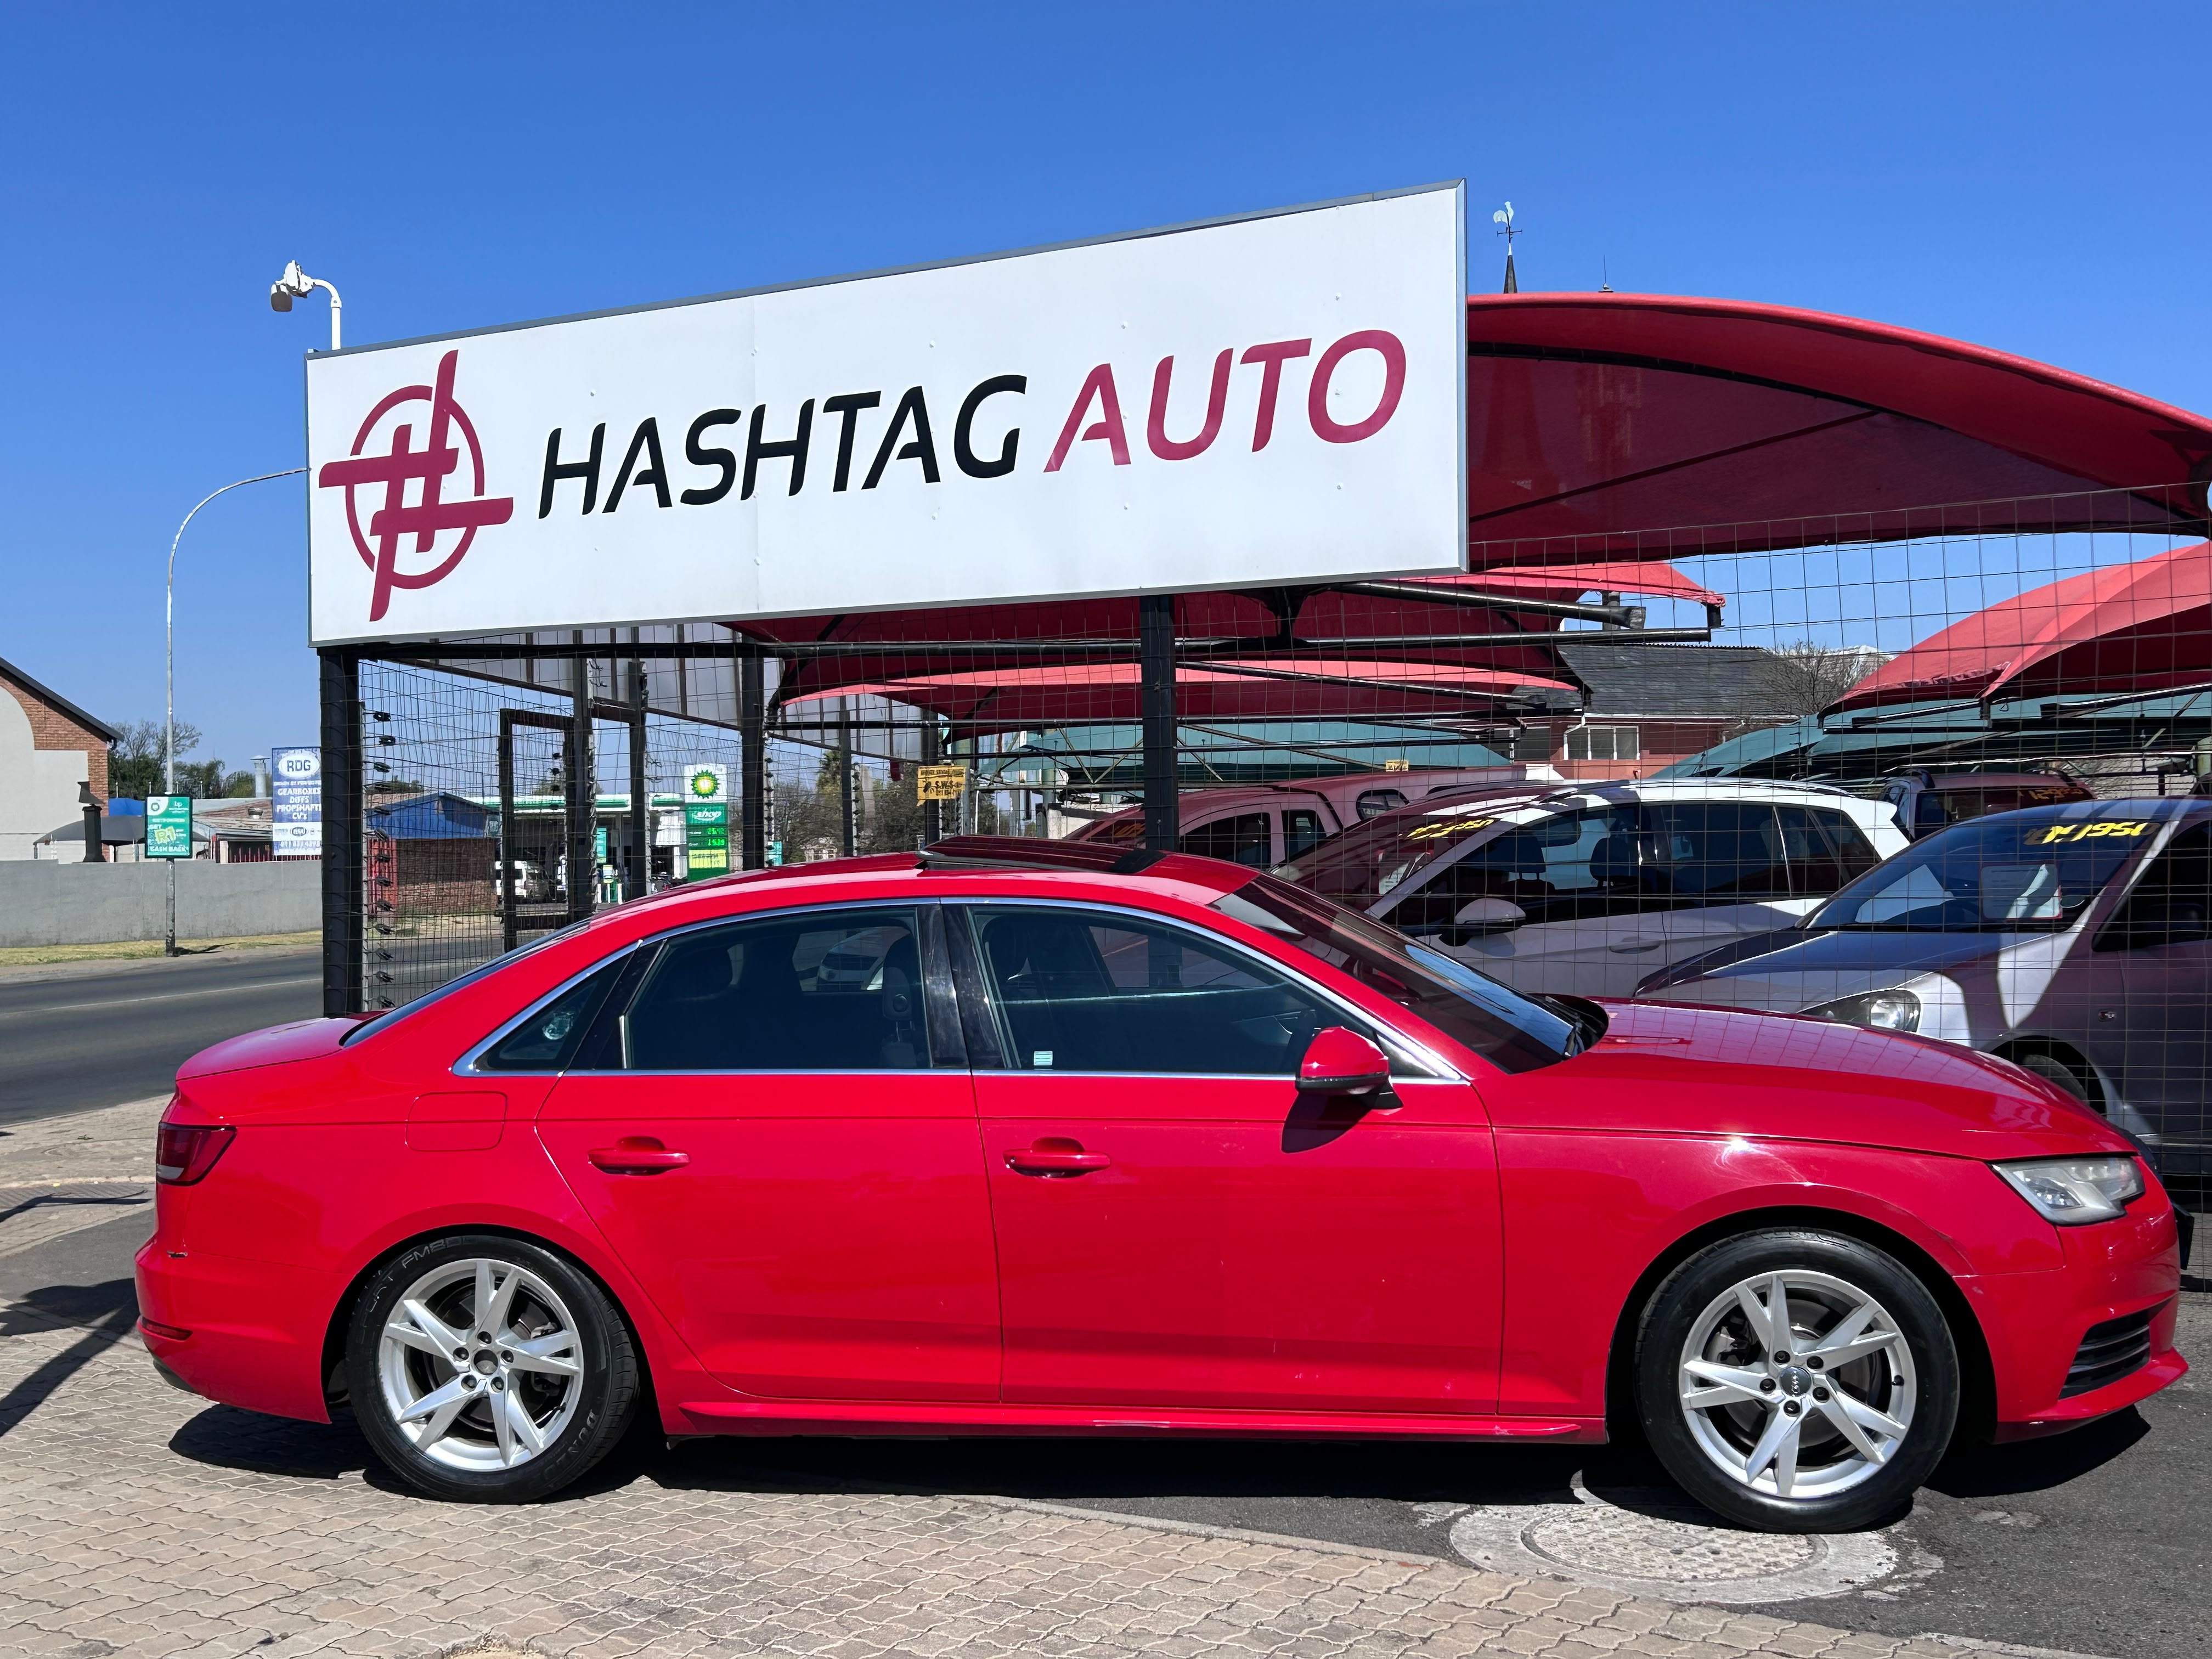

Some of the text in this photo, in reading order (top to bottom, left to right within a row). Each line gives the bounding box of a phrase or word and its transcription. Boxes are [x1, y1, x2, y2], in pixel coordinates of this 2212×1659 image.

[539, 330, 1406, 519] HASHTAG AUTO
[287, 759, 311, 772] RDG
[289, 795, 309, 804] DIFFS
